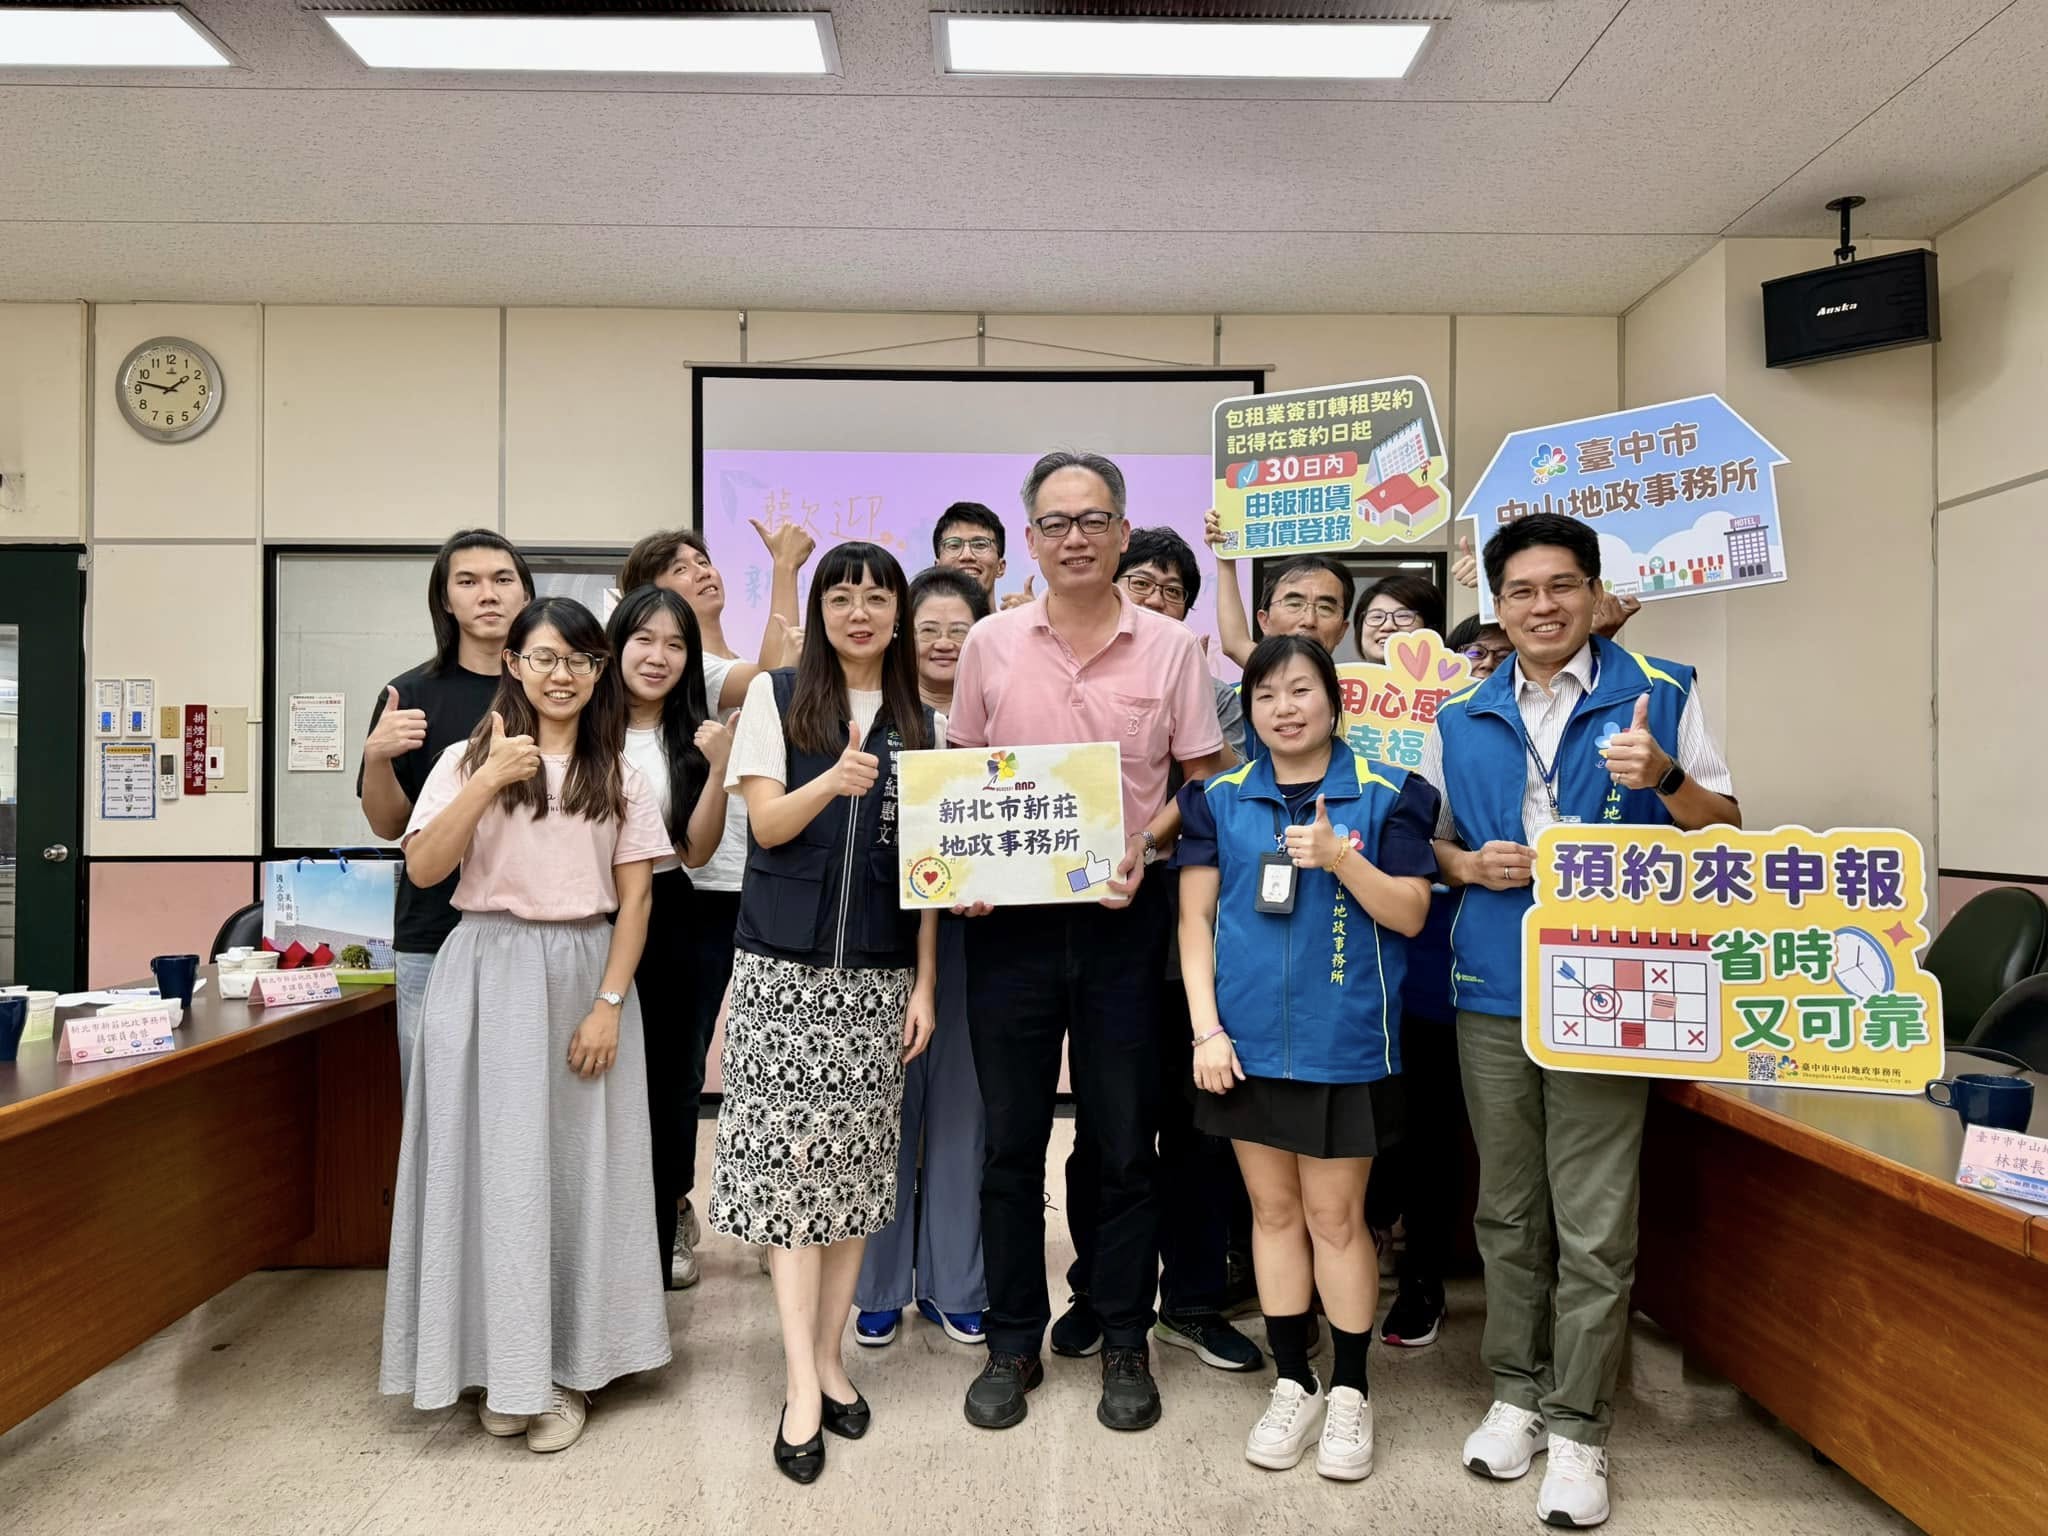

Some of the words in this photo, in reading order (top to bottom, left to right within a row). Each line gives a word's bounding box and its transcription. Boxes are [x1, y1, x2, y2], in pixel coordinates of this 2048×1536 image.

[151, 358, 160, 368] 11
[166, 354, 176, 365] 12
[184, 359, 189, 369] 1
[139, 369, 150, 380] 10
[194, 370, 201, 380] 2
[134, 384, 142, 394] 9
[198, 385, 206, 395] 3
[139, 399, 147, 409] 8
[193, 400, 201, 411] 4
[1225, 388, 1414, 430] 包租業簽訂轉租契約
[151, 410, 159, 421] 7
[166, 414, 174, 425] 6
[181, 411, 189, 421] 5
[1226, 420, 1373, 455] 記得在簽約日起
[1576, 422, 1698, 474] 臺中市
[1264, 453, 1344, 482] 30日內
[1245, 484, 1352, 519] 申報租賃
[1734, 516, 1757, 528] HOTEL
[1245, 516, 1352, 550] 實價登錄
[1347, 724, 1424, 767] 幸福
[939, 793, 1078, 824] 新北市新莊
[939, 829, 1081, 858] 地政事務所
[1554, 843, 1904, 907] 預約來申報
[1330, 880, 1348, 987] 山地政事務所
[1710, 929, 1833, 981] 省時
[1733, 994, 1929, 1050] 又可靠
[1802, 1062, 1902, 1077] 臺中市中山地政事務所
[1994, 1154, 2045, 1176] 林課長
